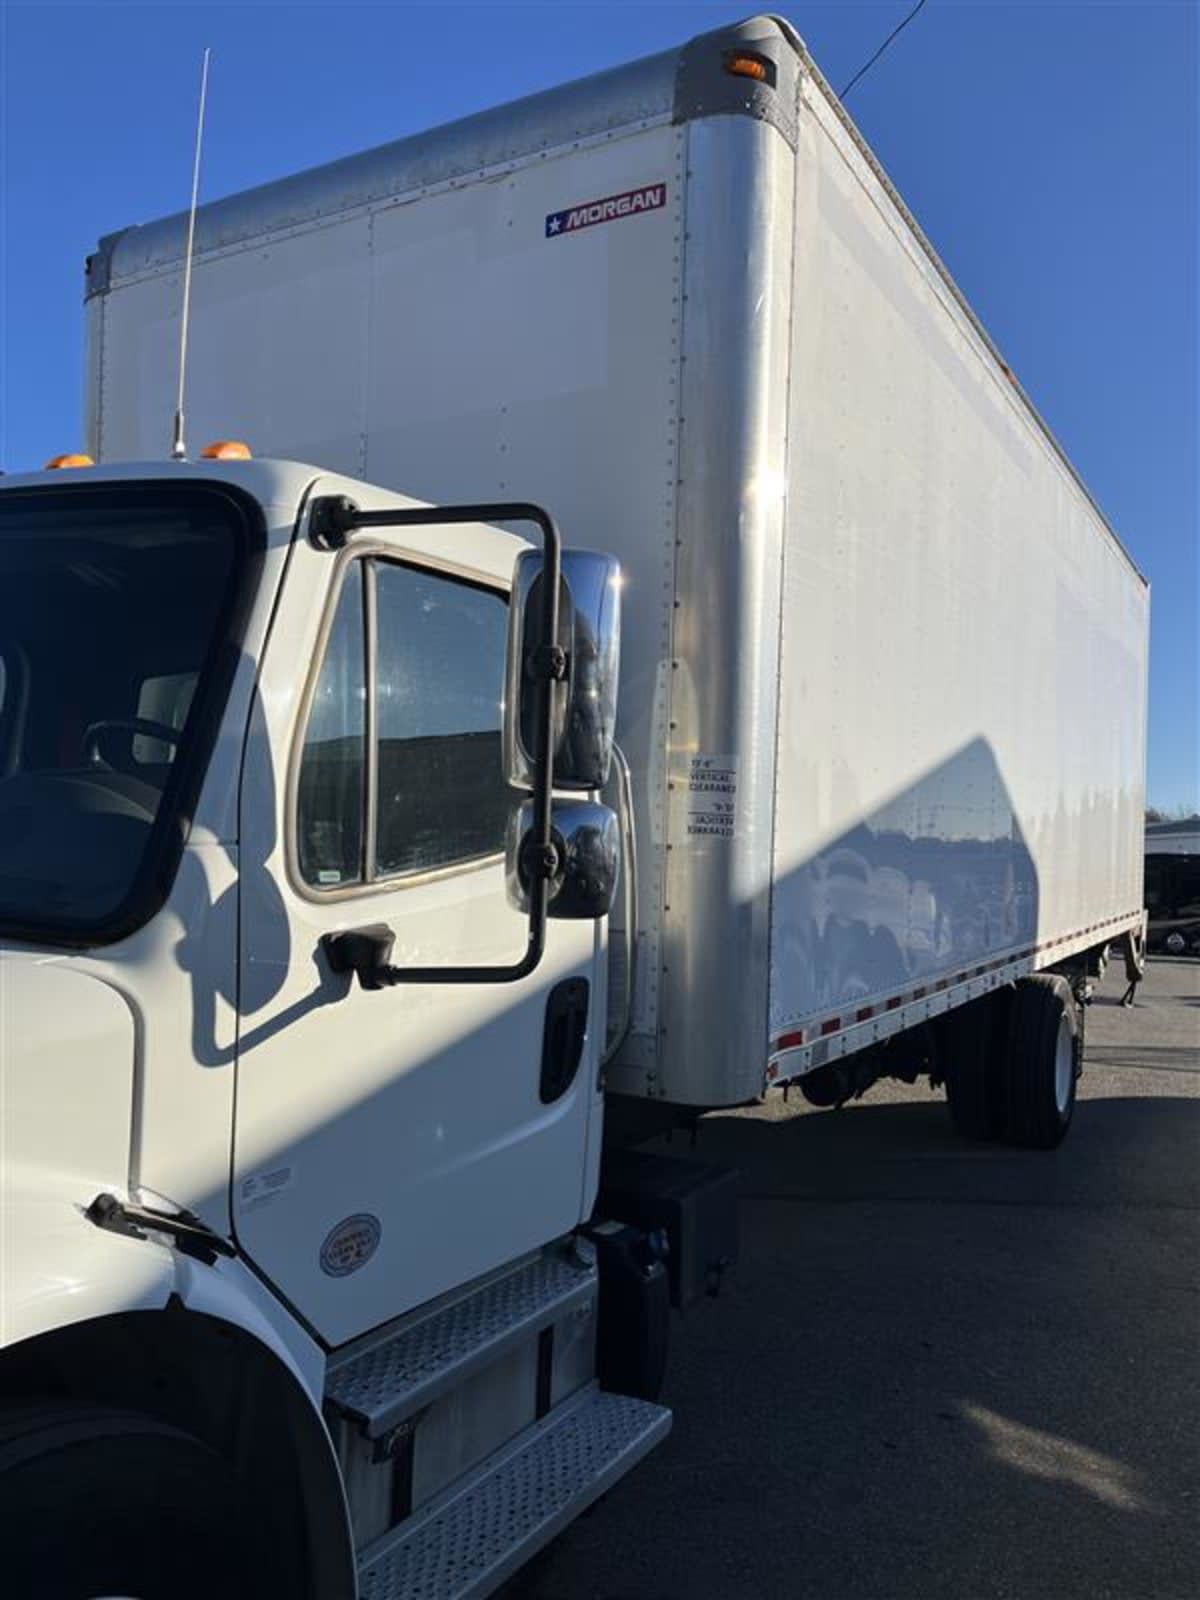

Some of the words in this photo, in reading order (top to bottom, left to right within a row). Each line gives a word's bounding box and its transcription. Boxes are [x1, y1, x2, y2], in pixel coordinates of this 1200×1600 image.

[566, 188, 662, 229] MORGAN
[690, 772, 729, 782] VERTICAL
[688, 783, 736, 794] CLEARANCE
